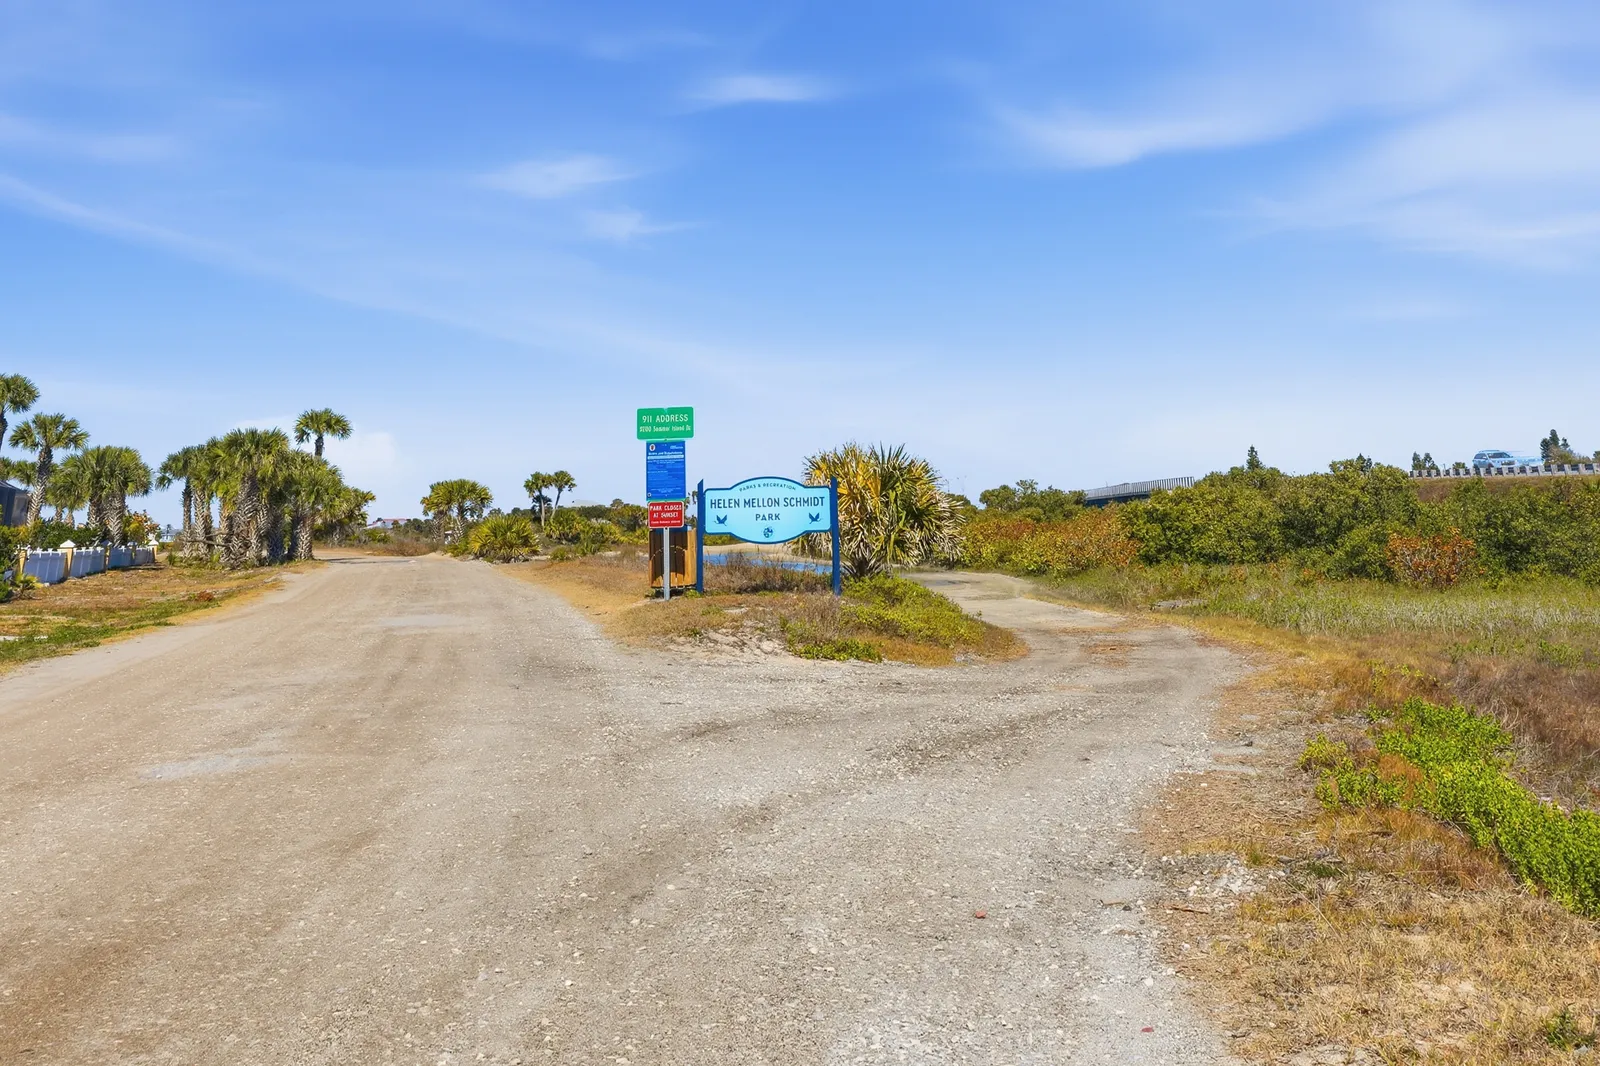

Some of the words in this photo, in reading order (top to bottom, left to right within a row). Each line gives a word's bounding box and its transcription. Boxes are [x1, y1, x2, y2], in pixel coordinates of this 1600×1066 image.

[642, 415, 652, 423] 911
[655, 413, 689, 423] ADDRESS
[739, 483, 757, 492] PARKS
[762, 482, 796, 491] RECREATION
[710, 498, 740, 509] HELEN
[743, 497, 780, 508] MELLON
[783, 496, 825, 508] SCHMIDT
[660, 511, 679, 519] SUNSET
[755, 513, 781, 521] PARK
